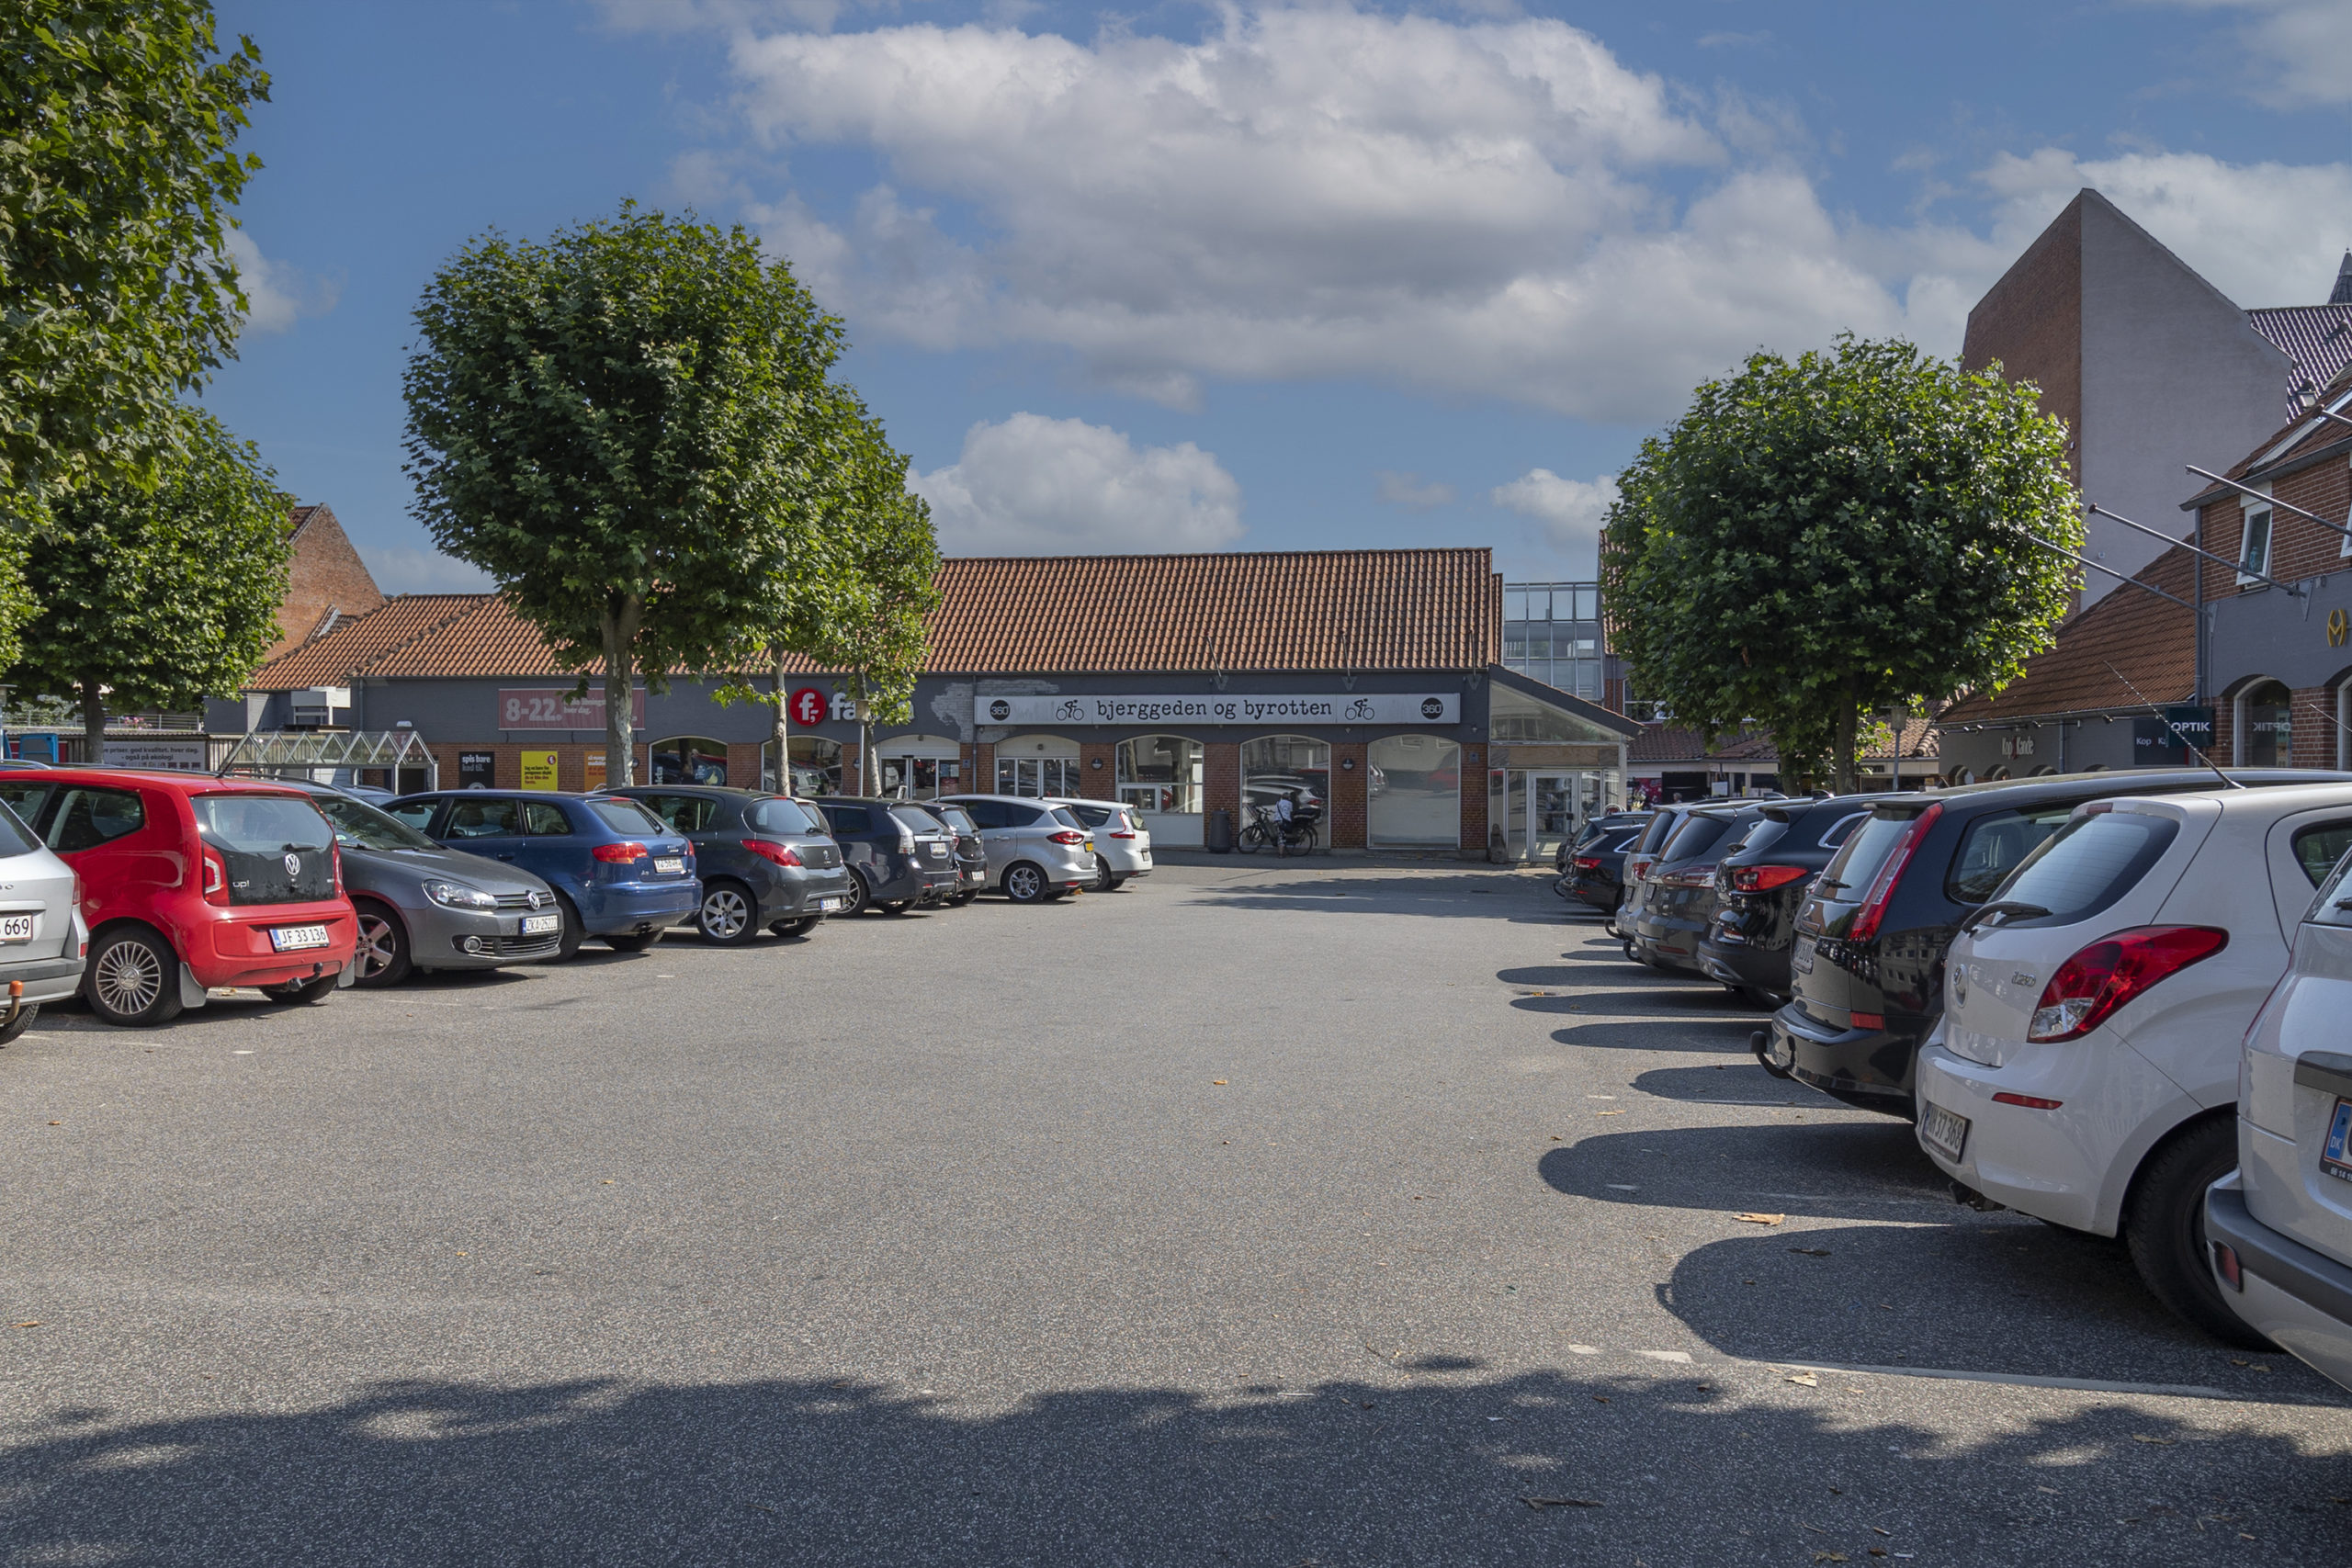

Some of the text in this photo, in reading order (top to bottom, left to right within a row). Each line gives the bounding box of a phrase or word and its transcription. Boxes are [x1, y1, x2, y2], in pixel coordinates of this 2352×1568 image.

[1096, 699, 1332, 720] bjerggeden og byrotten
[2171, 722, 2211, 732] OPTIK
[2136, 738, 2152, 746] Kop
[5, 919, 29, 935] 669
[282, 928, 327, 944] JF 33 136
[1944, 1116, 1963, 1150] 368
[2330, 1135, 2343, 1150] DK
